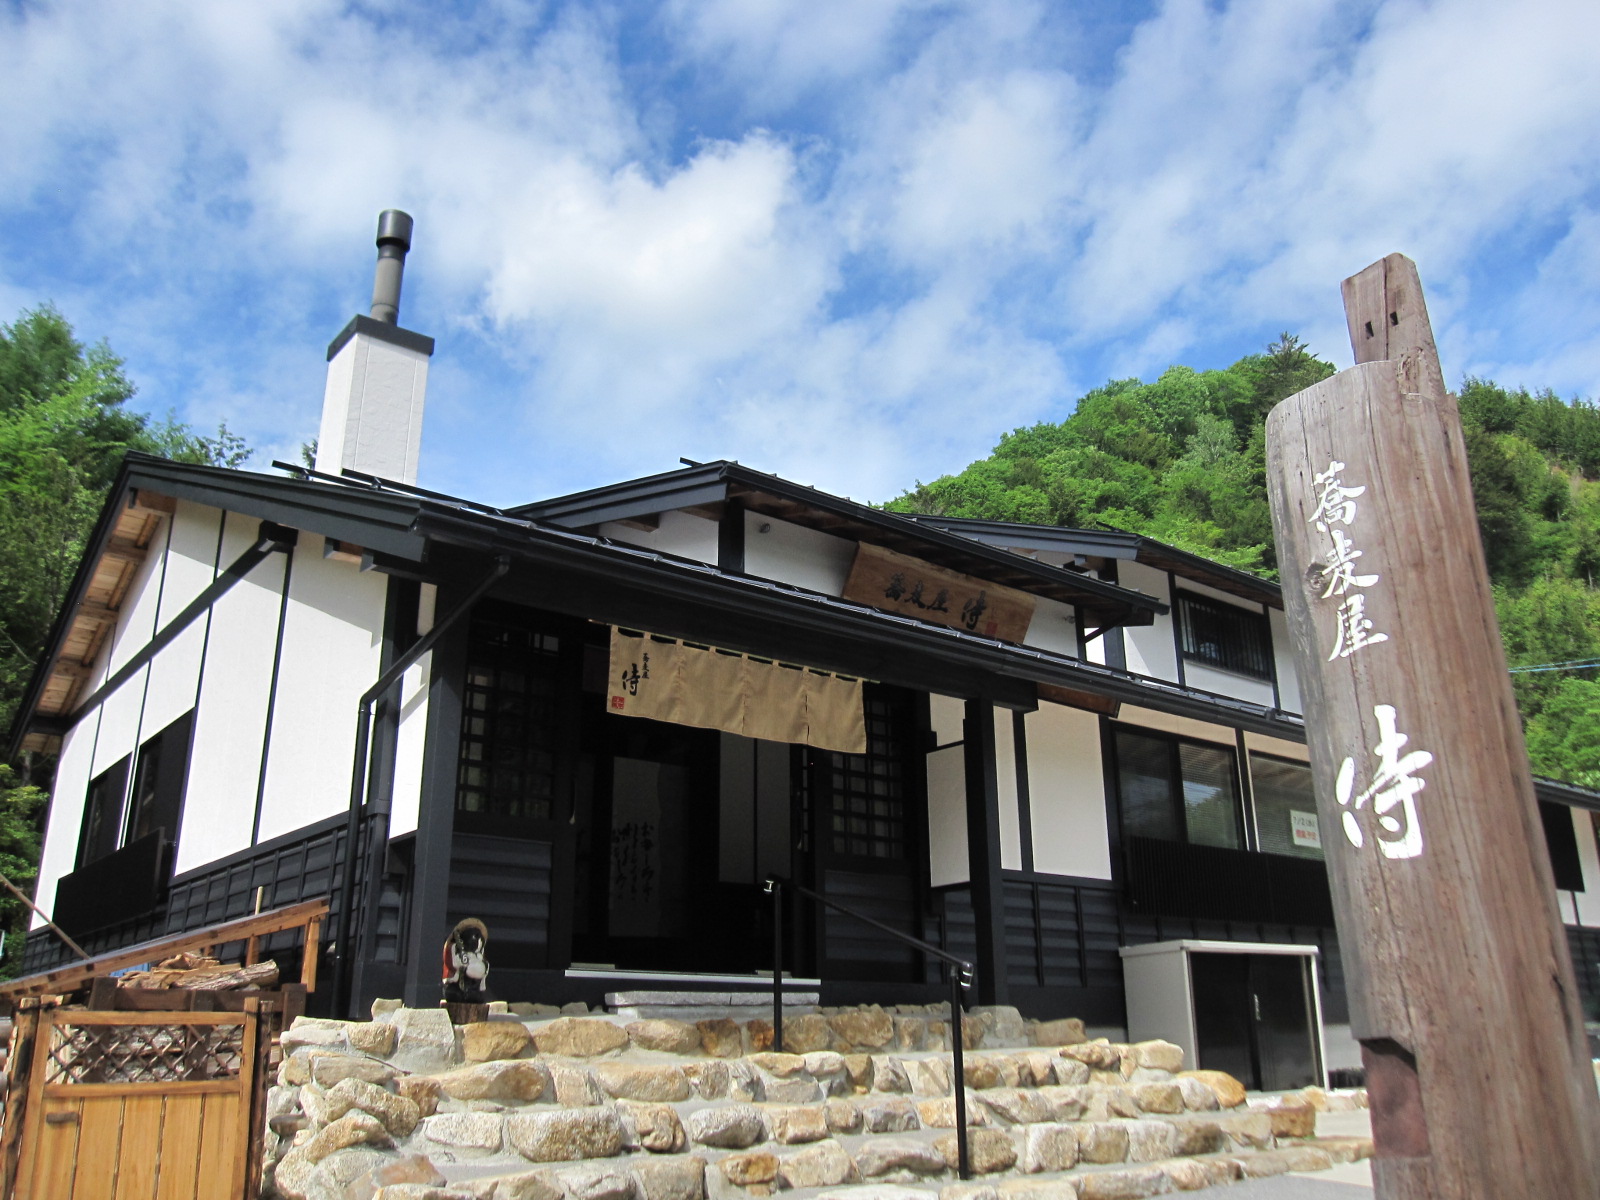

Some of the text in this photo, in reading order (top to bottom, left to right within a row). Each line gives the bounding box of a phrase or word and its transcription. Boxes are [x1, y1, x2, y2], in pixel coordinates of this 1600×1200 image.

[961, 590, 986, 630] 侍
[622, 663, 641, 696] 侍
[1308, 461, 1433, 859] 蕎麦屋 侍
